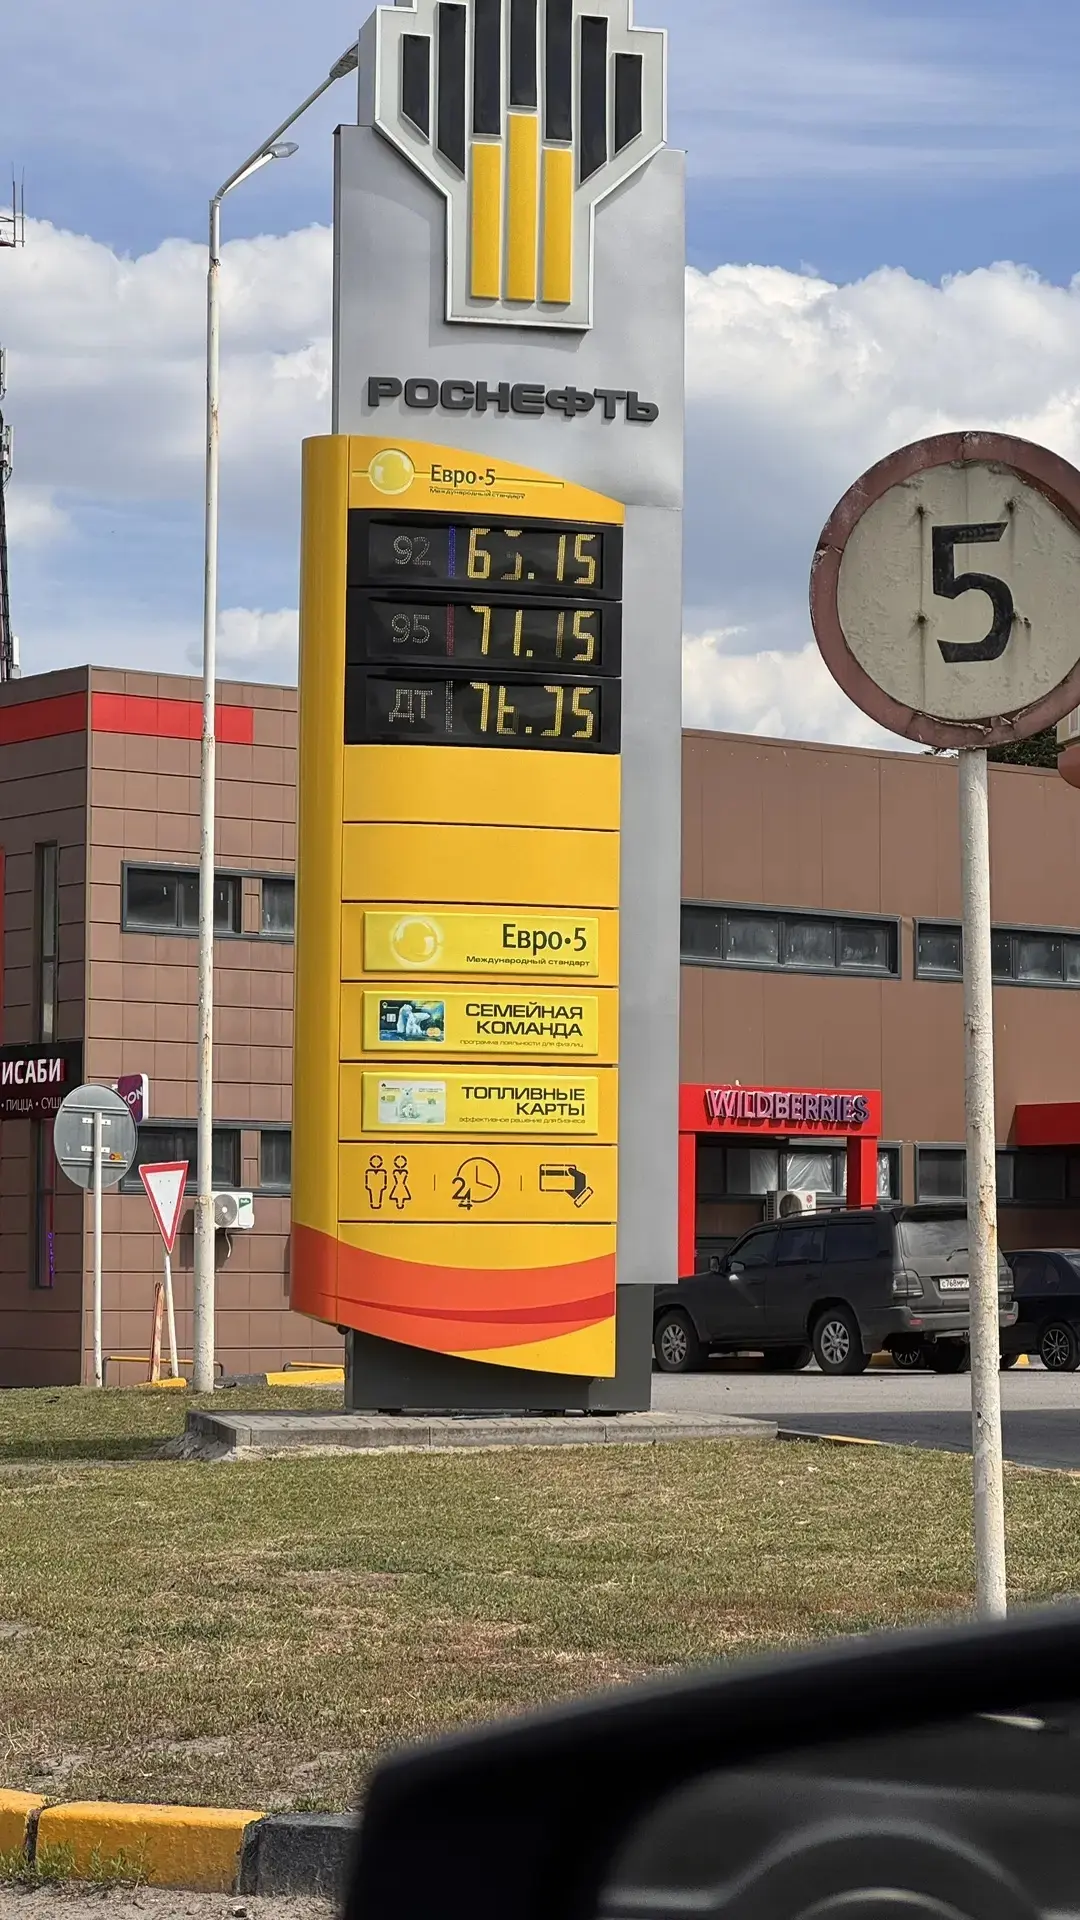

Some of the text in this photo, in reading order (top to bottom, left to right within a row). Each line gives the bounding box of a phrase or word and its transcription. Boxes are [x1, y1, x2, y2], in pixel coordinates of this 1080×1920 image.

[367, 376, 660, 423] РОСНЕФТЬ
[393, 535, 432, 566] 92
[931, 521, 1014, 664] 5
[391, 605, 595, 662] 95 71.15
[388, 688, 434, 723] ДТ
[466, 955, 590, 968] Международный стандарт
[465, 1001, 583, 1020] СЕМЕЙНАЯ
[476, 1020, 583, 1039] КОМАНДА
[123, 1086, 143, 1105] ON
[461, 1086, 585, 1101] ТОПЛИВНЫЕ
[6, 1096, 65, 1112] ПИЦЦА СУШ
[516, 1102, 585, 1116] КАРТЫ
[704, 1089, 870, 1123] WILDBERRIES
